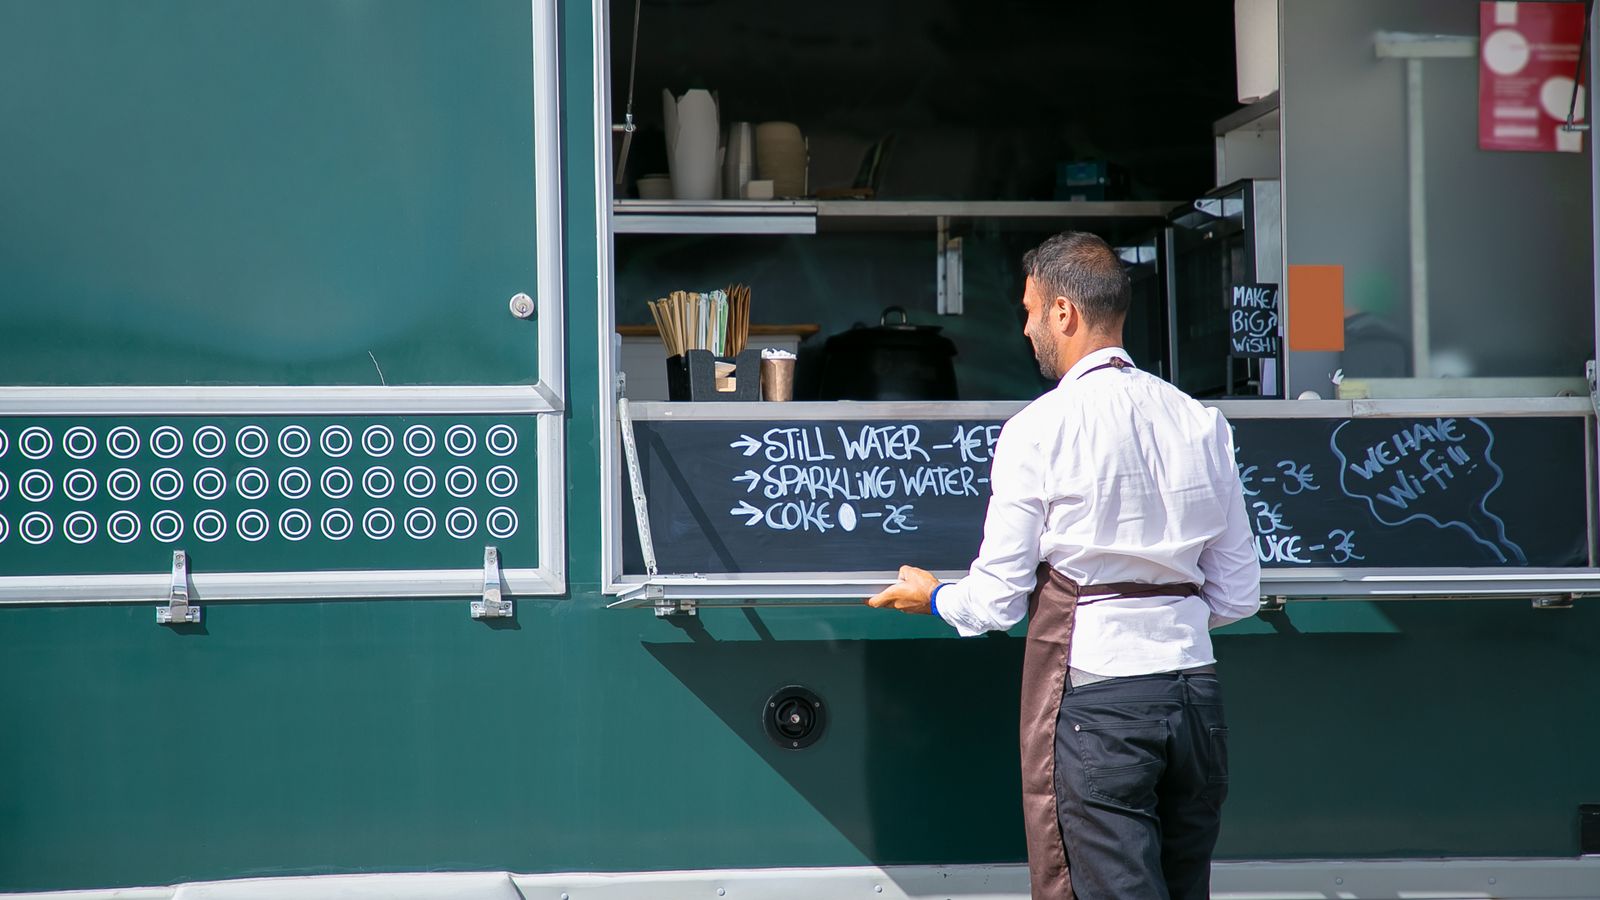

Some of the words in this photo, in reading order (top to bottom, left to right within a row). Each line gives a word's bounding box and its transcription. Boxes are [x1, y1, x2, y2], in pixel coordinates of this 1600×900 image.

[1233, 286, 1270, 308] MAKE
[838, 425, 930, 462] WATER
[1350, 441, 1400, 480] WE
[1392, 418, 1466, 456] HAVE
[765, 500, 835, 533] COKE
[1252, 501, 1293, 534] 3€
